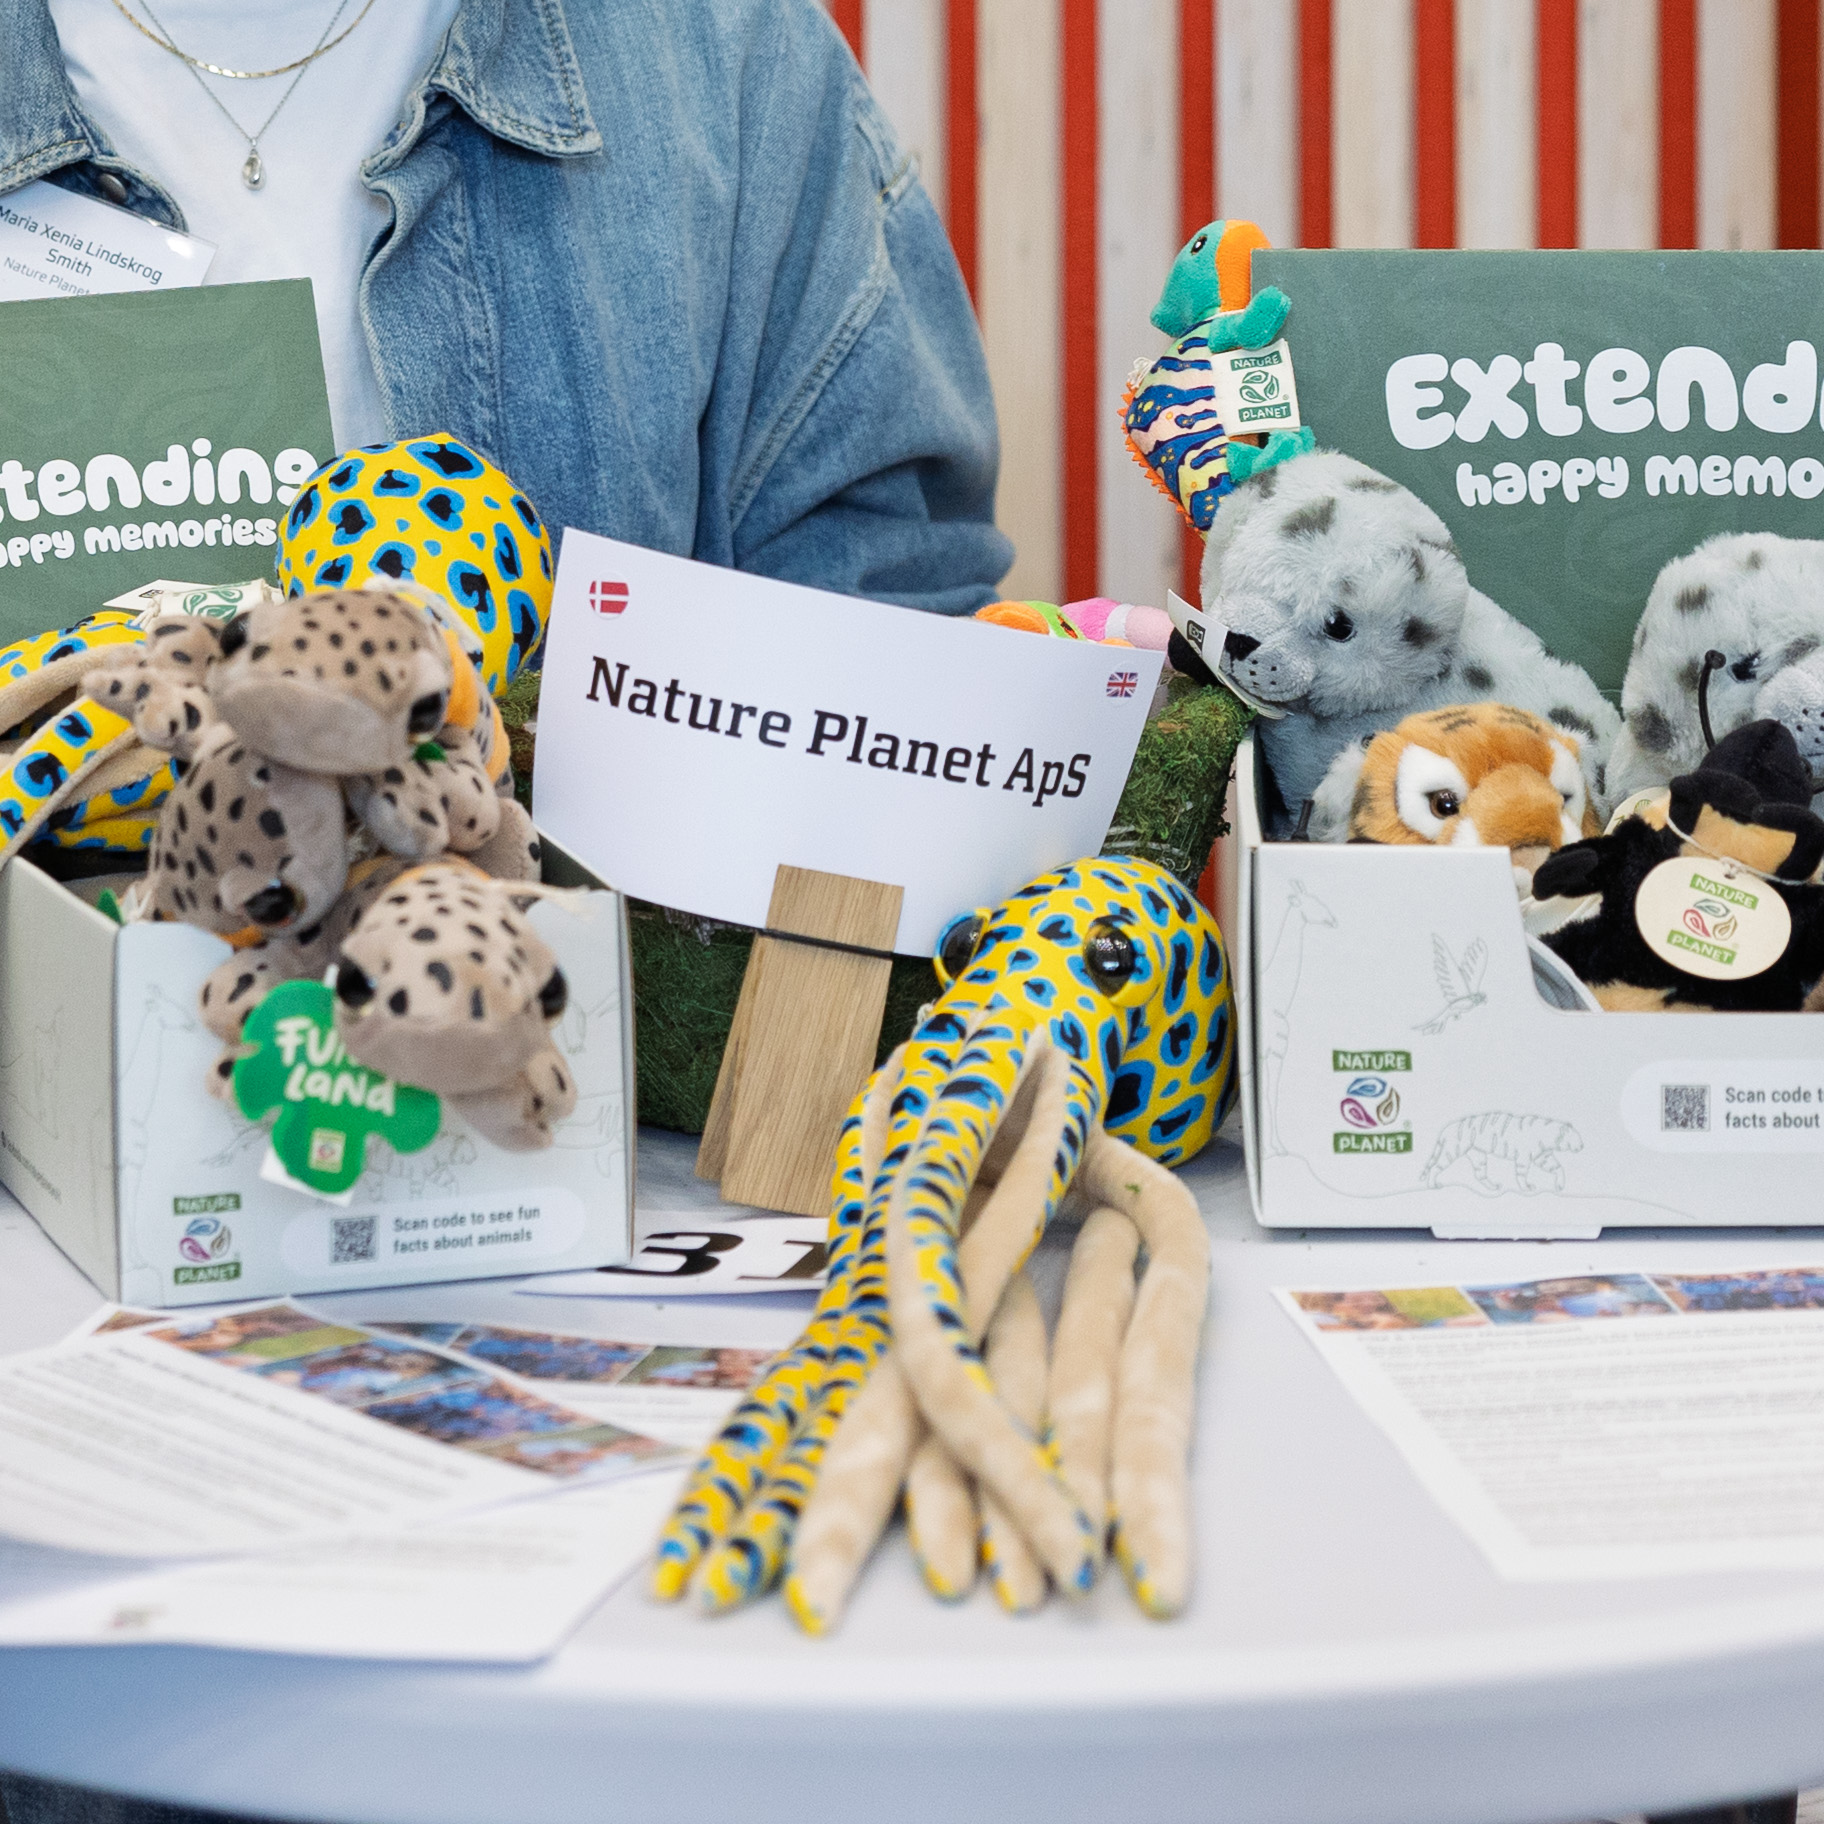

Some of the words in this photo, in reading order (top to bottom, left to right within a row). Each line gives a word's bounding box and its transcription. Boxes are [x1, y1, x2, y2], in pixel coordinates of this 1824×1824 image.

[40, 223, 84, 251] Xenia
[86, 241, 163, 286] Lindskrog
[46, 248, 92, 277] Smith
[4, 256, 47, 283] Nature
[1234, 354, 1279, 369] NATURE
[1242, 405, 1287, 420] PLANET
[1455, 455, 1630, 507] happy
[83, 514, 277, 555] memories
[586, 655, 792, 749] Nature
[805, 709, 996, 788] Planet
[1002, 747, 1092, 808] ApS
[1695, 877, 1755, 908] NATURE
[1671, 934, 1733, 963] PLANET
[1338, 1052, 1407, 1070] NATURE
[1725, 1086, 1766, 1103] Scan
[1771, 1086, 1812, 1103] code
[1725, 1111, 1767, 1129] facts
[1772, 1111, 1821, 1129] about
[1338, 1134, 1408, 1153] PLANET
[393, 1216, 429, 1233] Scan
[432, 1212, 467, 1229] code
[471, 1211, 485, 1226] to
[489, 1209, 514, 1224] see
[518, 1205, 541, 1220] fun
[393, 1239, 430, 1255] facts
[433, 1234, 474, 1251] about
[477, 1228, 533, 1247] animals
